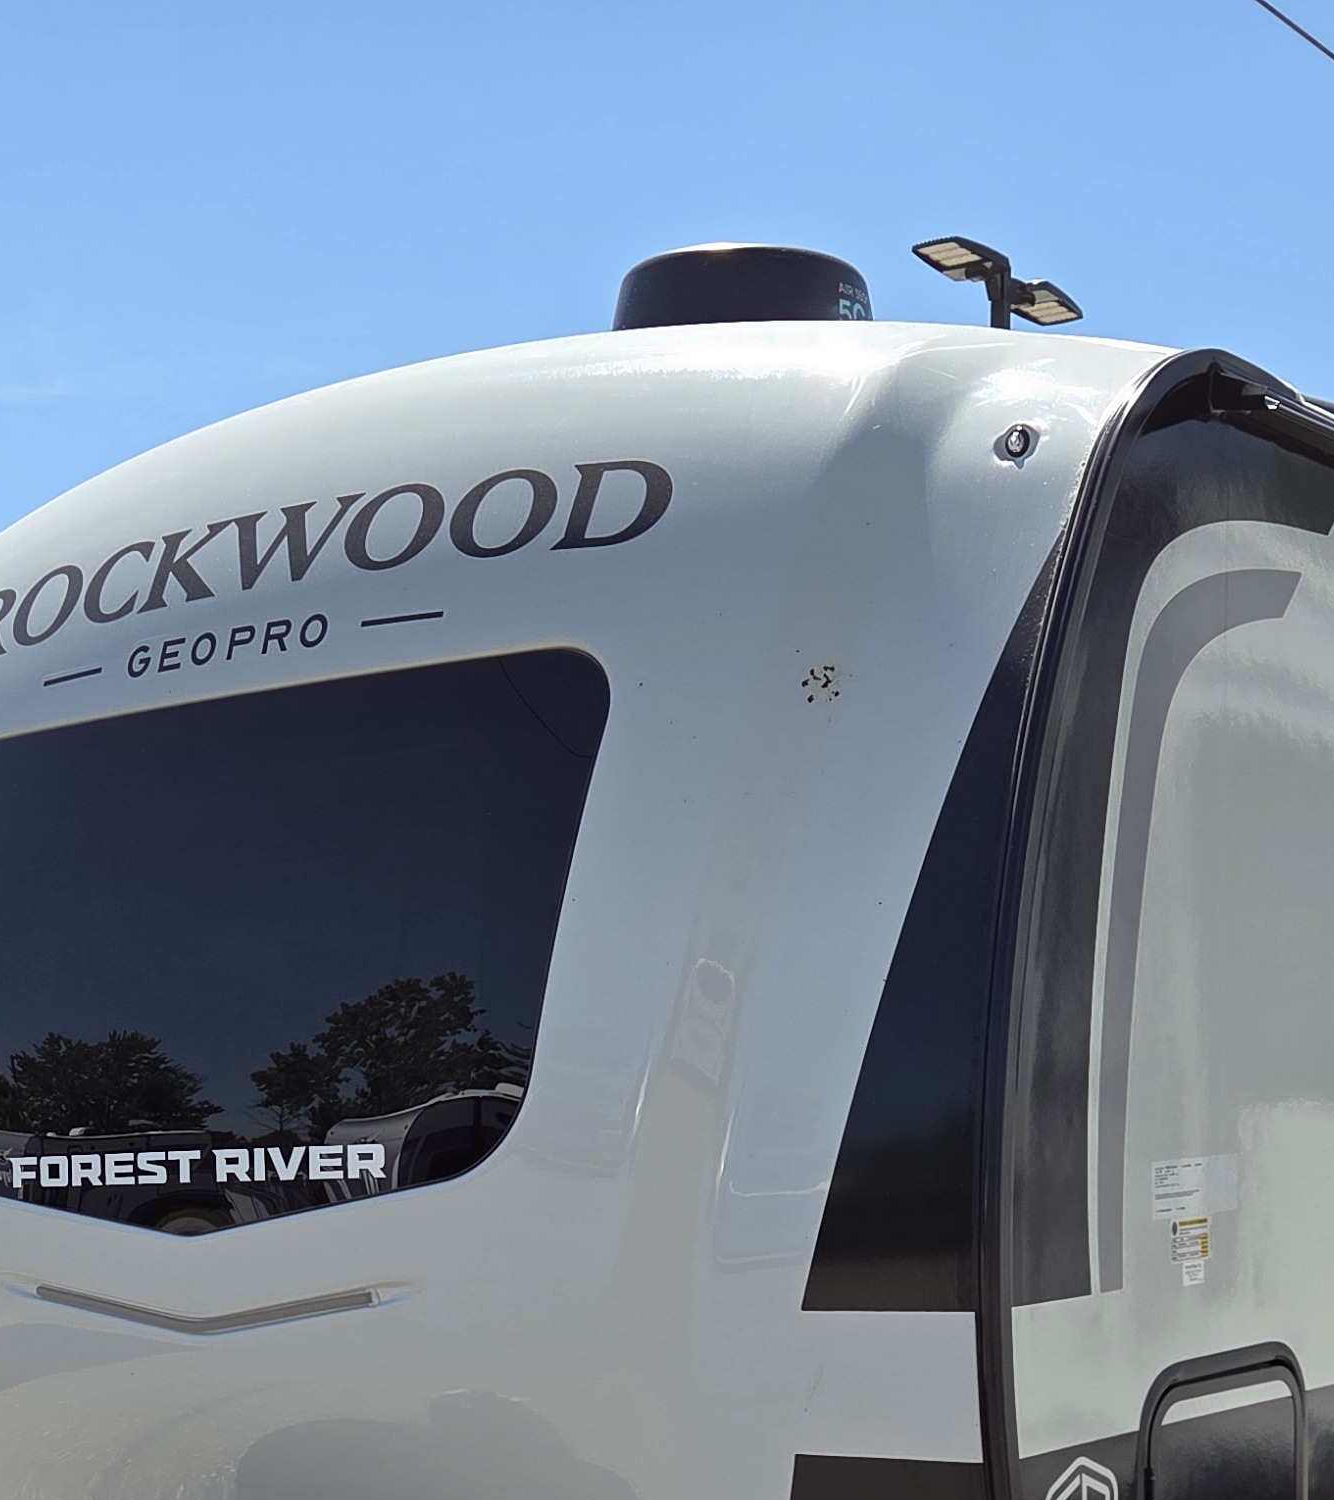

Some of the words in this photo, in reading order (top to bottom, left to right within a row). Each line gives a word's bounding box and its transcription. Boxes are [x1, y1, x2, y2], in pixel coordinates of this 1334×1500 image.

[838, 282, 854, 297] AIR
[127, 613, 329, 679] GEOPRO
[9, 1150, 201, 1188] FOREST
[212, 1143, 387, 1183] RIVER
